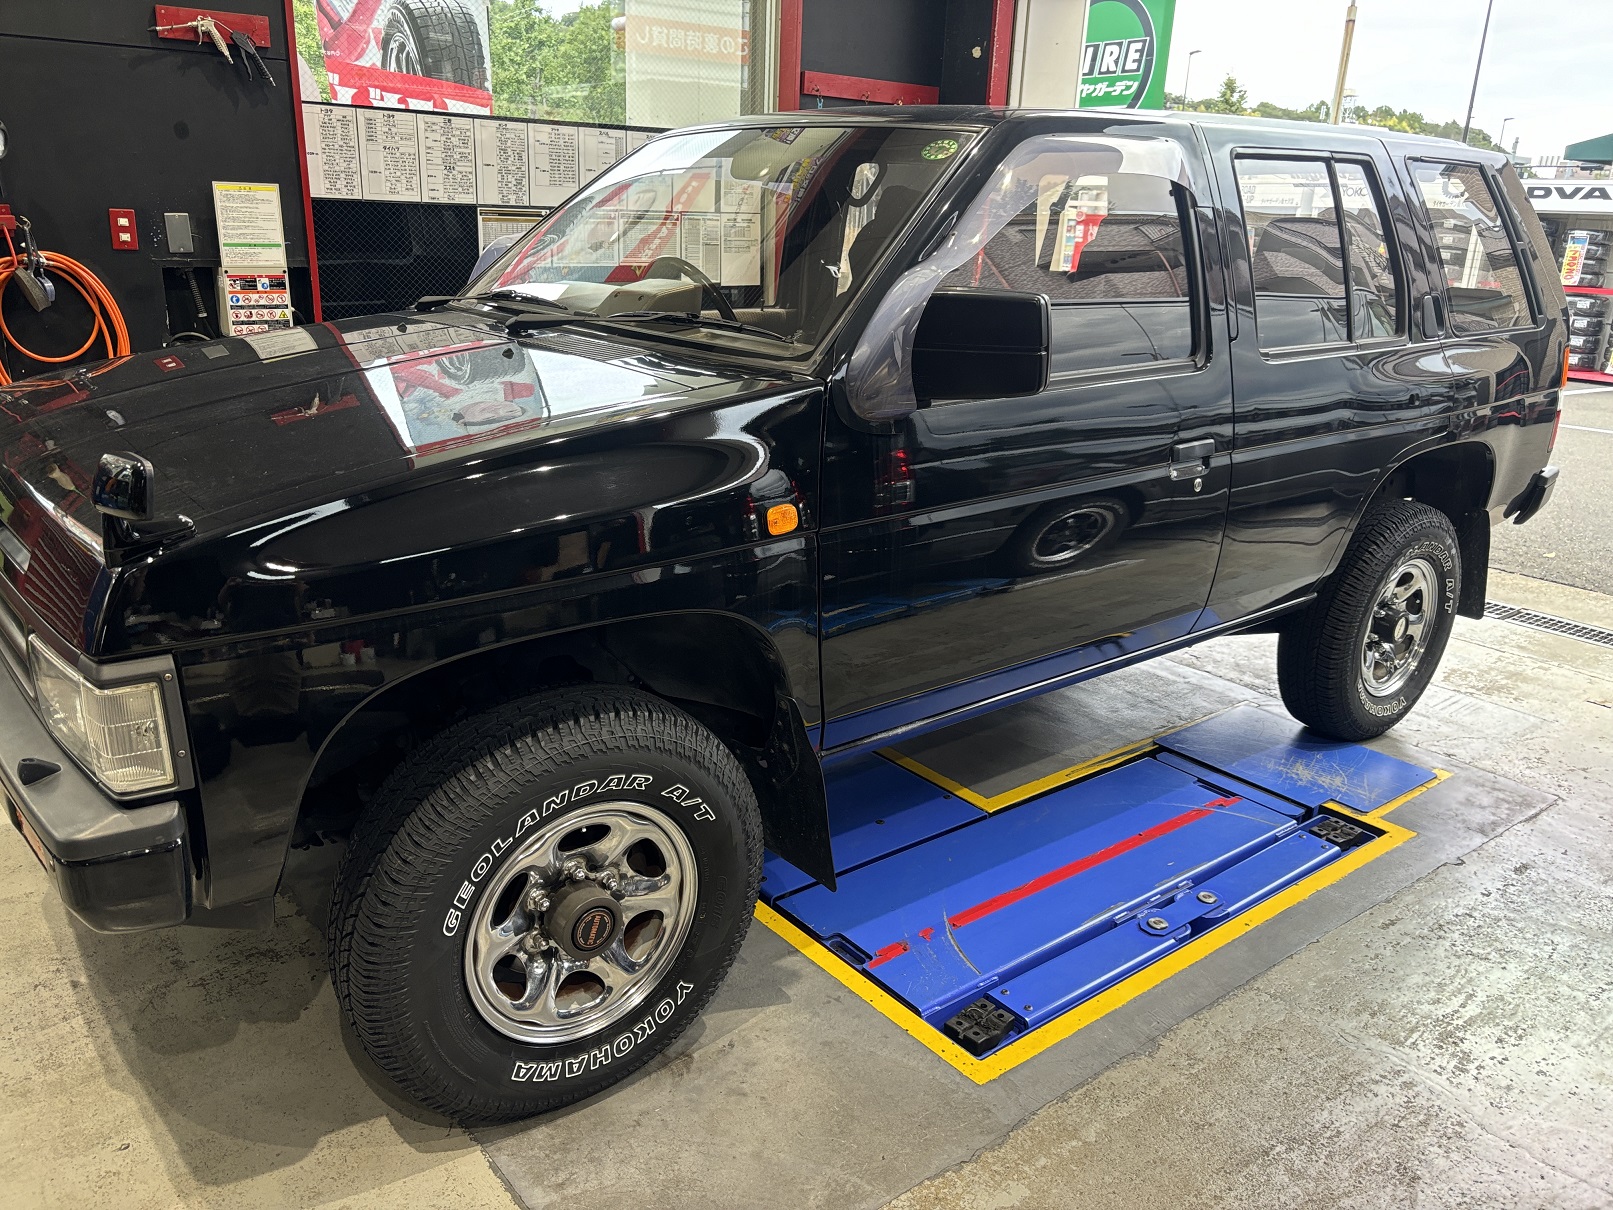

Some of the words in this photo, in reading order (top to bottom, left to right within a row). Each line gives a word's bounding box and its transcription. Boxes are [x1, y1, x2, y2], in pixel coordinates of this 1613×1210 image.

[1082, 41, 1143, 74] IRE
[1526, 186, 1613, 201] DVA
[442, 774, 653, 937] GEOLANDAR
[661, 784, 716, 823] A/T
[510, 979, 695, 1083] YOKOHAMA
